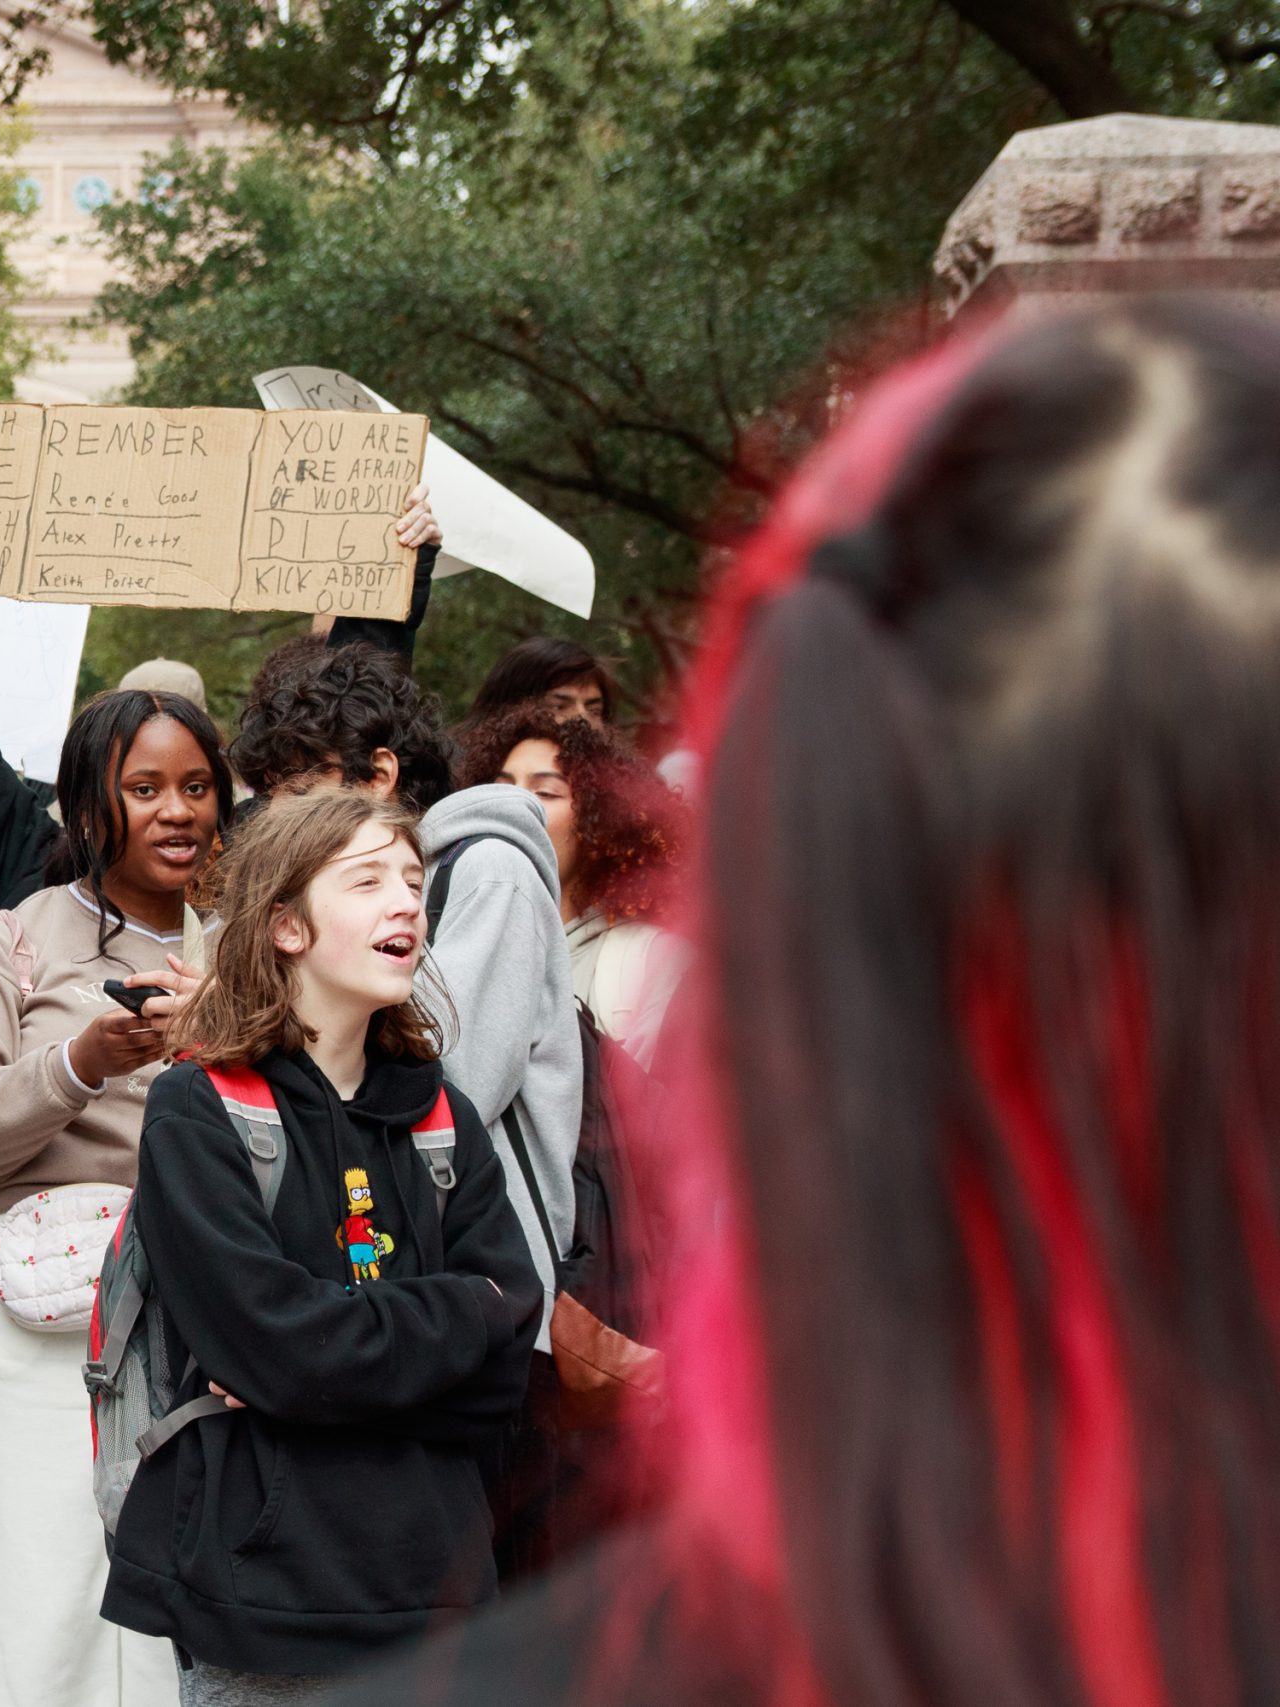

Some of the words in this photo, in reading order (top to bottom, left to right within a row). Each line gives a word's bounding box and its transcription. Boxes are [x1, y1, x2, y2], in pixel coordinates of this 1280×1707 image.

[46, 419, 208, 457] REMBER
[279, 419, 344, 455] YOU
[361, 423, 409, 453] ARE
[272, 459, 337, 485] ARE
[347, 458, 417, 482] AFRAID
[158, 485, 199, 505] Good
[270, 486, 295, 509] OF
[41, 519, 87, 545] Alex
[113, 522, 182, 548] Pretty
[268, 517, 396, 565] PIGS
[38, 563, 83, 588] Keith
[104, 568, 155, 589] Porter
[255, 565, 313, 595] KICK
[324, 565, 400, 588] ABBOTT
[316, 589, 383, 614] OUT!
